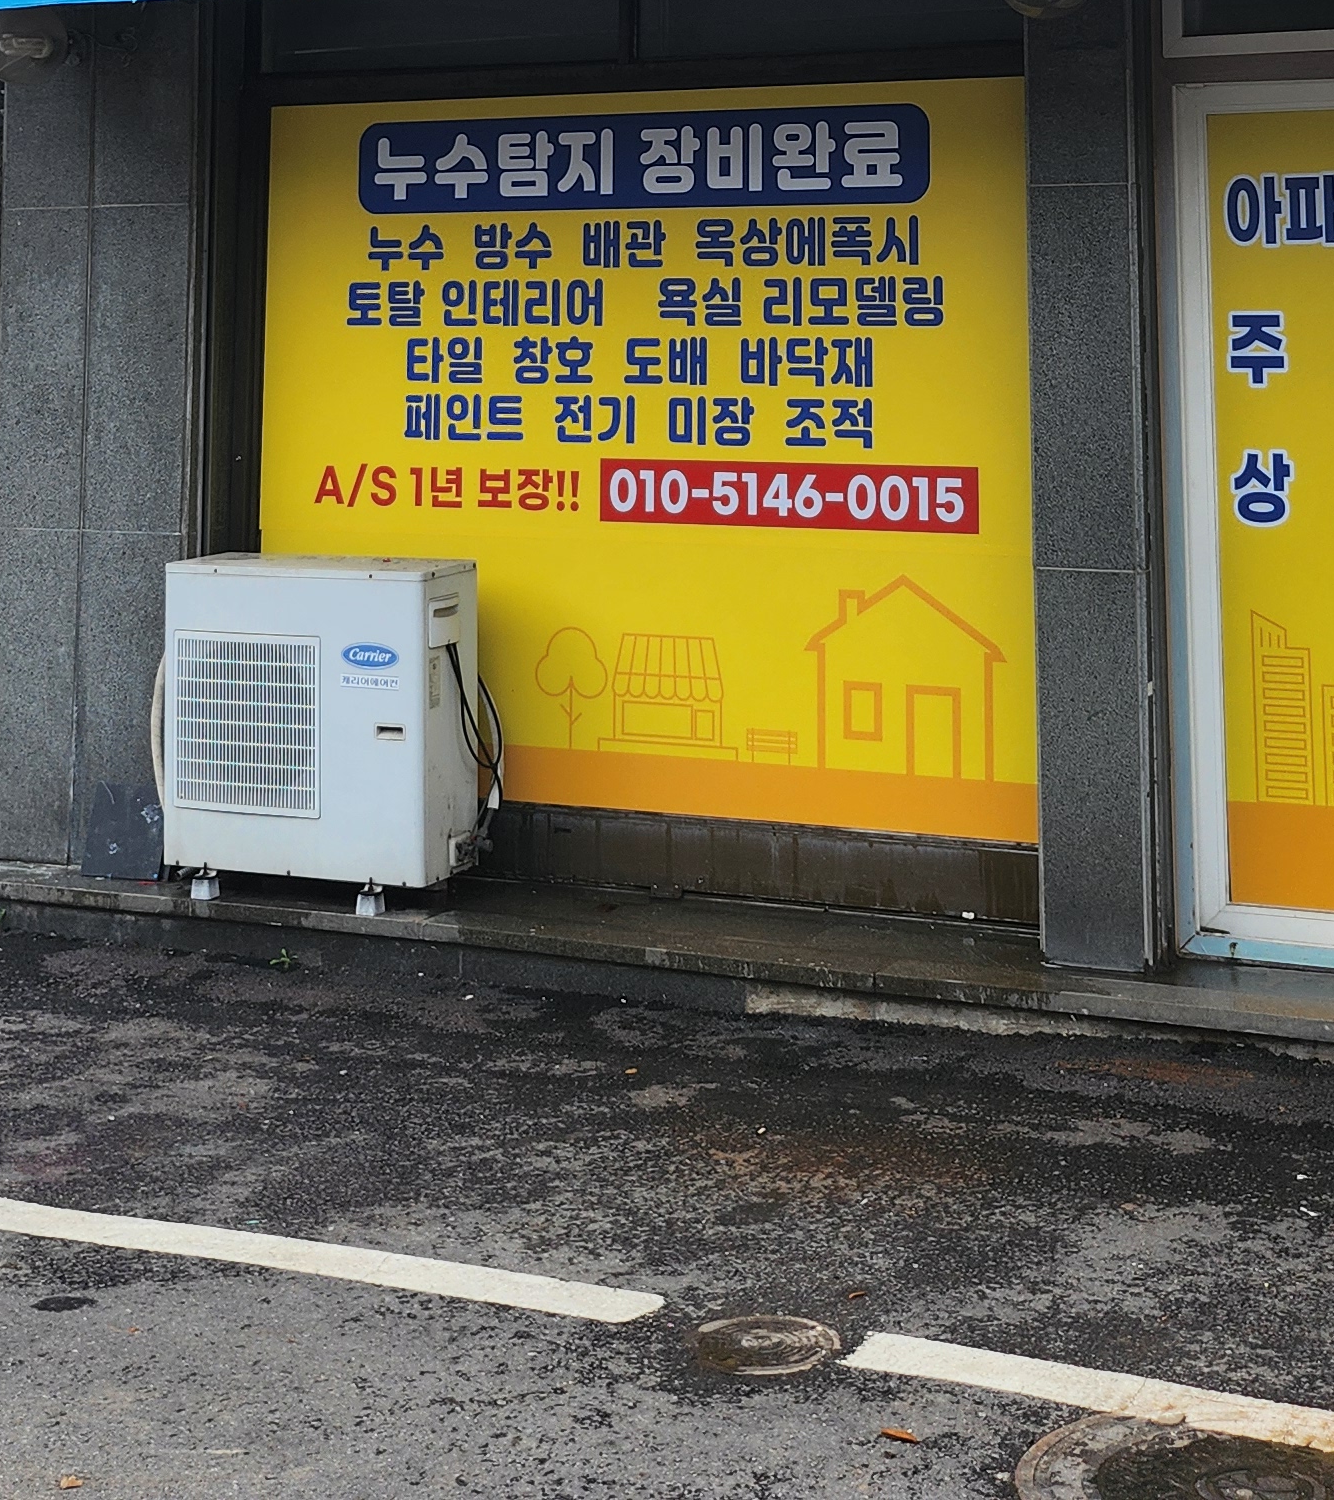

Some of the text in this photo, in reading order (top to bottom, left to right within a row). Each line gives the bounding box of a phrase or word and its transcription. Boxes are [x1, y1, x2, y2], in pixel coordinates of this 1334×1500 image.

[373, 120, 904, 200] 누수탐지 장비완료
[367, 214, 920, 271] 누수 방수 배관 옥상에폭시
[346, 275, 945, 328] 토탈 인테리어 욕실 리모델링
[406, 335, 874, 389] 타일 창호 도배 바닥재
[404, 392, 874, 450] 페인트 전기 미장 조적
[314, 462, 581, 513] A/S 1년 보장!!
[608, 467, 965, 524] 010-5146-0015
[349, 637, 392, 663] Carrier
